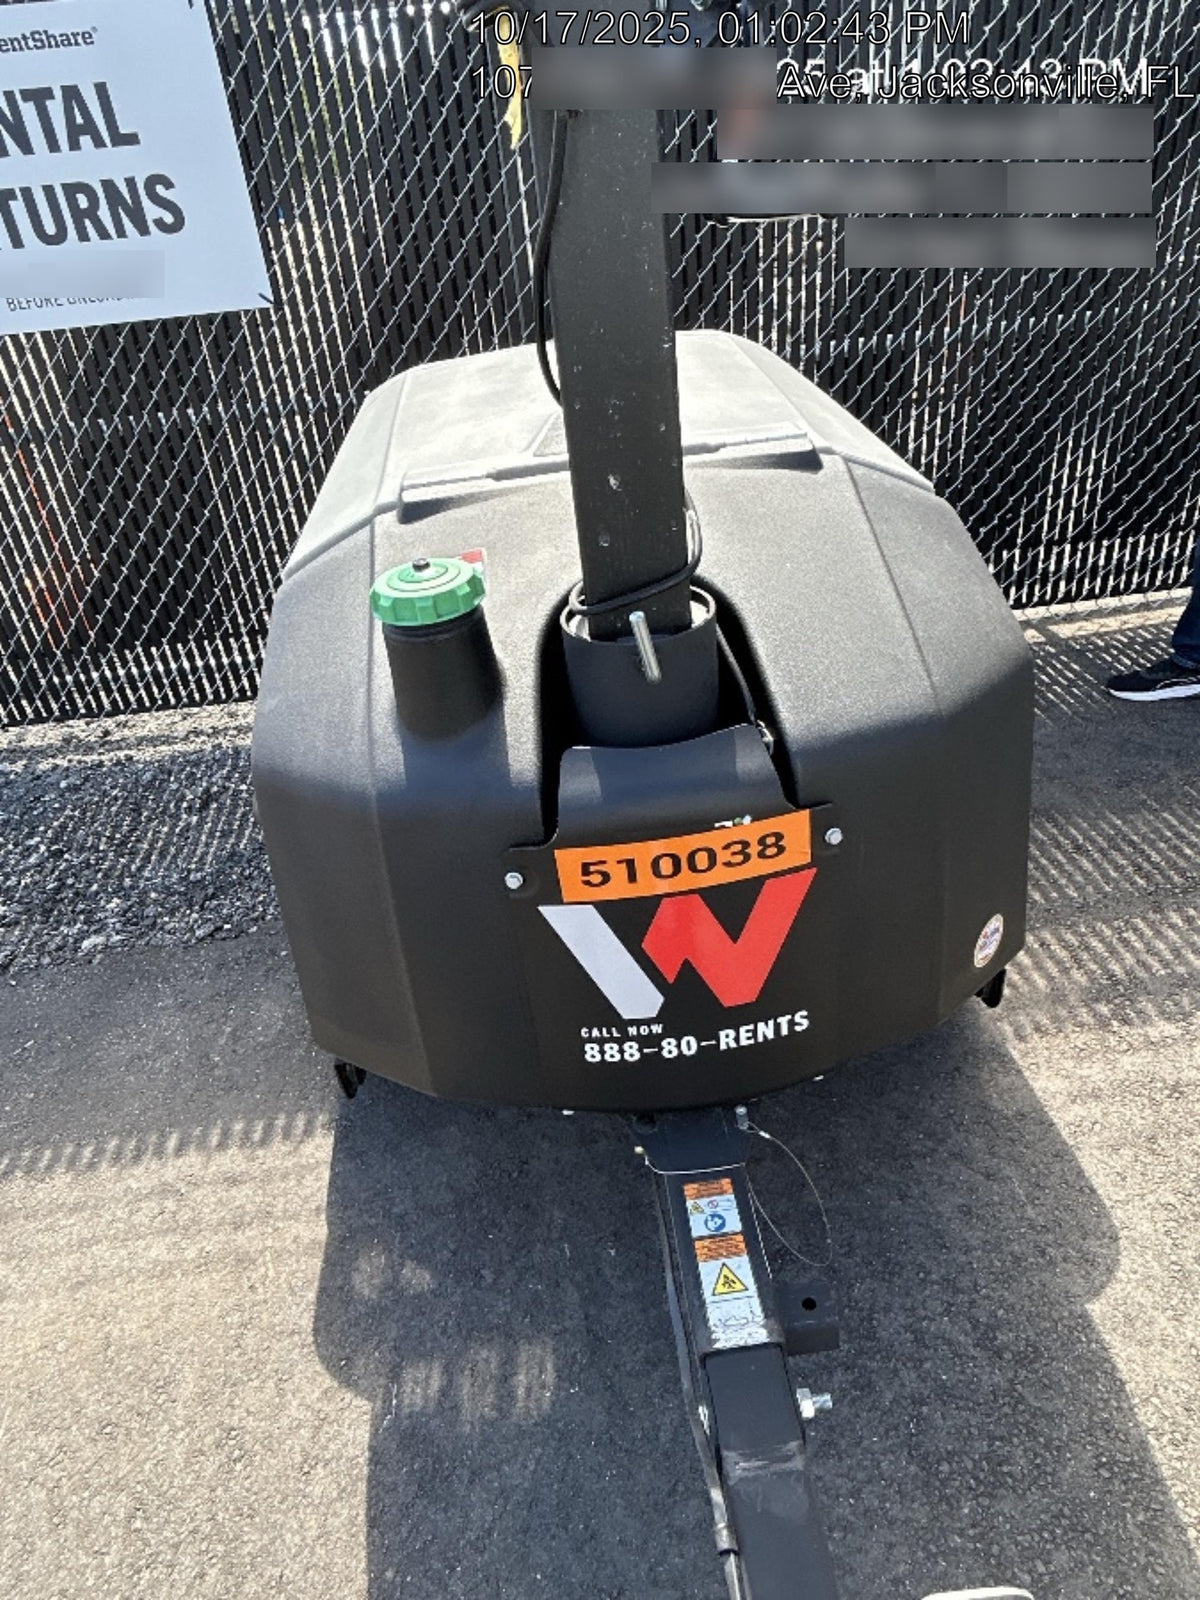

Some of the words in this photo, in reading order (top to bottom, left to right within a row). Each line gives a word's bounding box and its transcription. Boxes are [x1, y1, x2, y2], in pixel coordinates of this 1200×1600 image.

[0, 81, 141, 158] NTAL
[0, 173, 186, 249] TURNS
[580, 831, 788, 888] 510038
[580, 1026, 622, 1038] CALL
[627, 1023, 664, 1037] NOW
[583, 1009, 810, 1063] 888-80-RENTS
